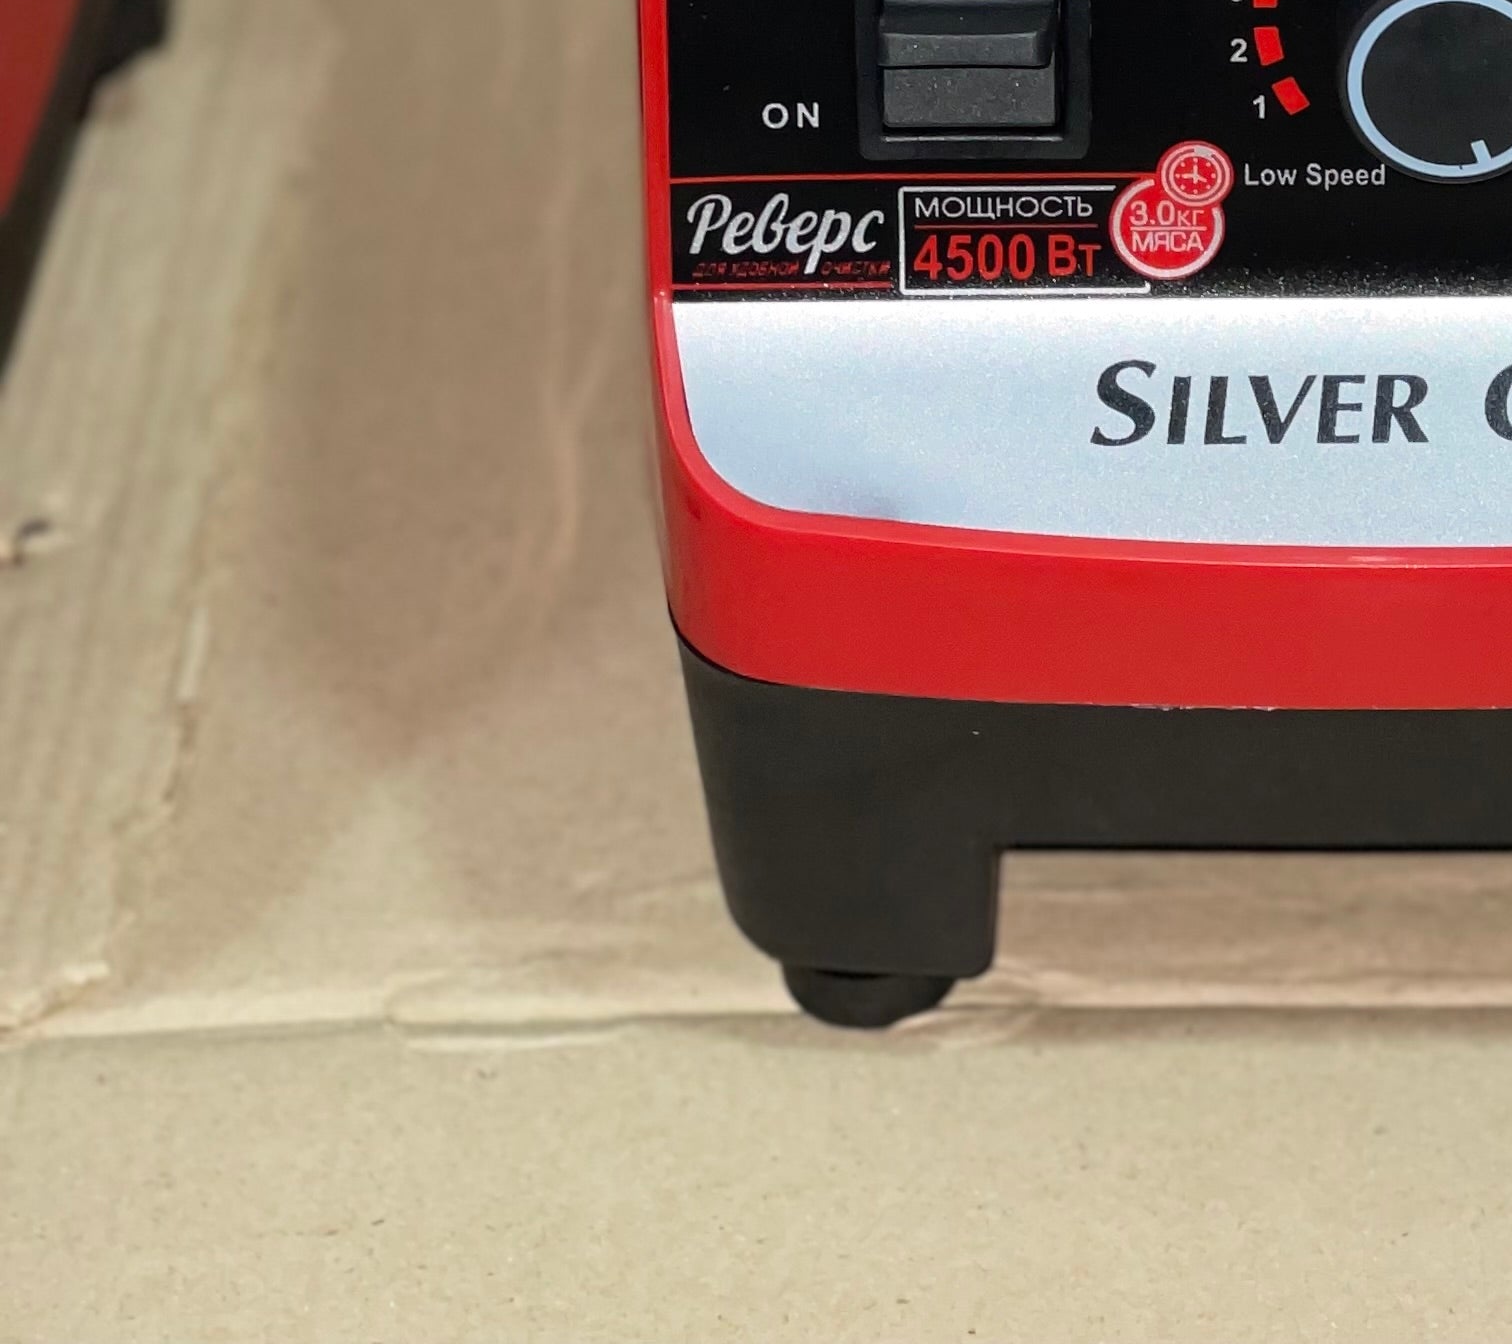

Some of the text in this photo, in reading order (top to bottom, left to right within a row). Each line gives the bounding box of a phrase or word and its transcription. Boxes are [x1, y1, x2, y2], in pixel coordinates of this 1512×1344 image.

[1229, 38, 1248, 63] 2
[760, 101, 821, 130] ON
[1252, 94, 1266, 119] 1
[1244, 162, 1386, 191] Low Speed
[914, 196, 1094, 220] МОЩНОСТЬ
[687, 192, 884, 275] Реверс
[1131, 231, 1205, 253] МЯСА
[913, 233, 1103, 281] 4500 Вт
[1089, 358, 1430, 447] SILVER
